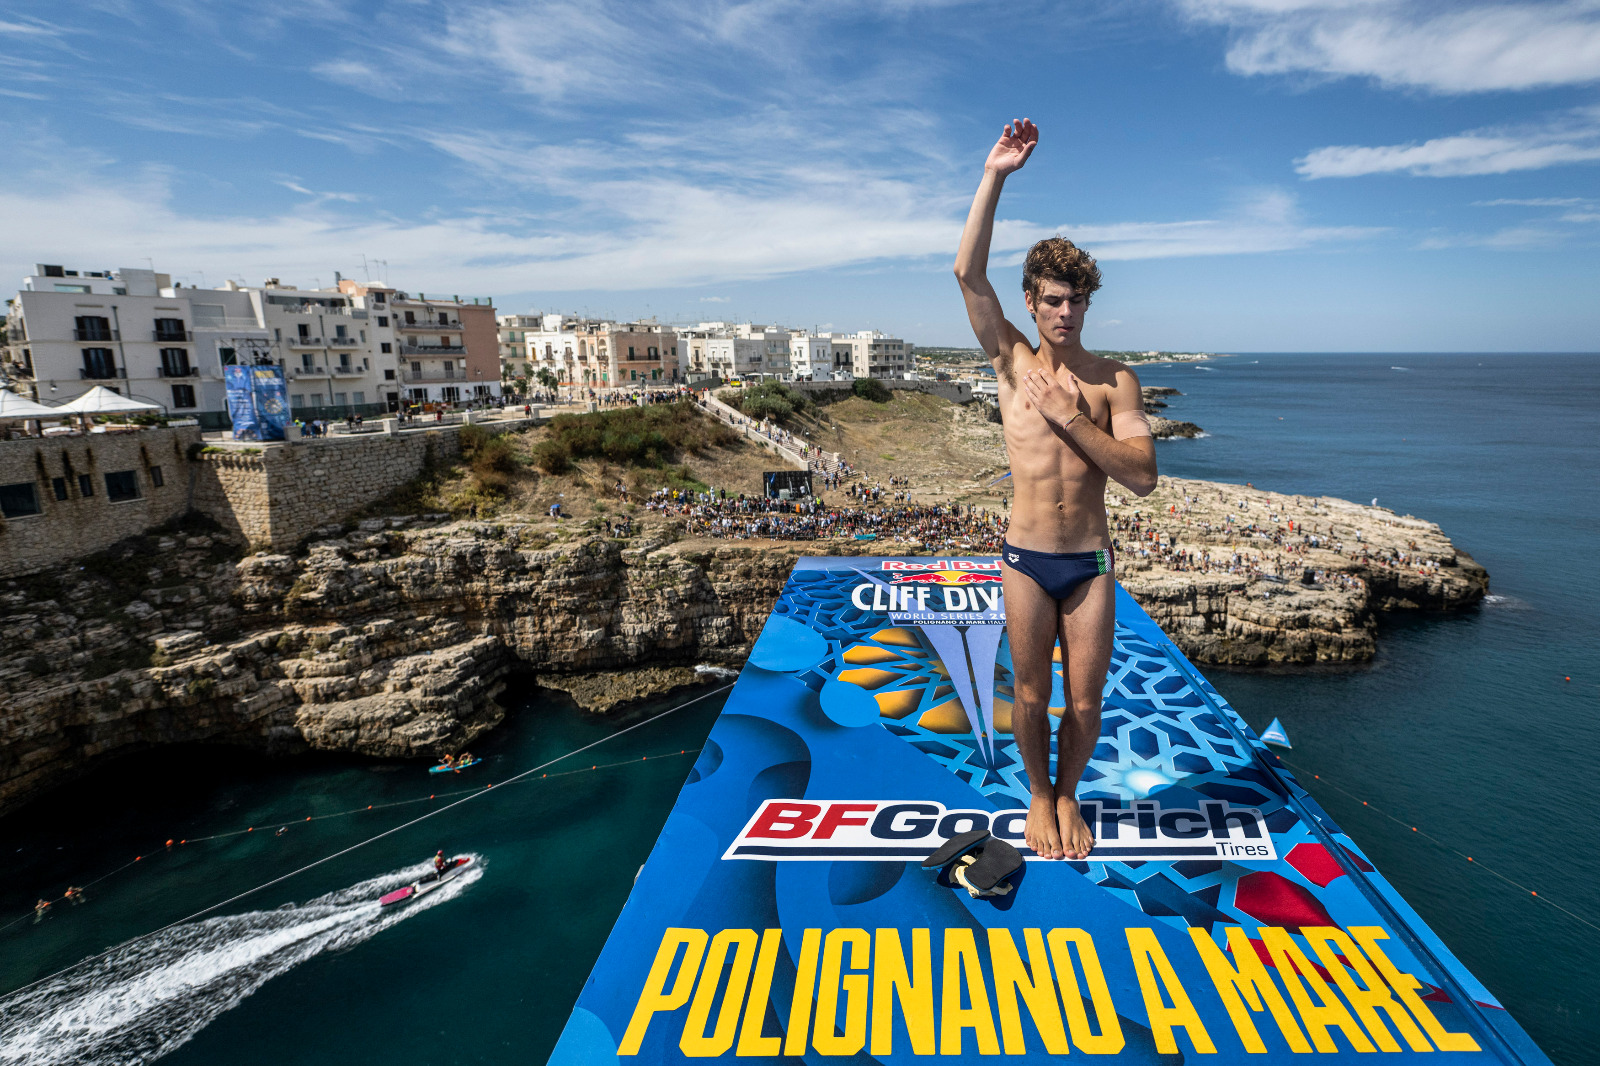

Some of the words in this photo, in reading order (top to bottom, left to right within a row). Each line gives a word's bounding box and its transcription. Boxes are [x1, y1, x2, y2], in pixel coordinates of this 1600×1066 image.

[881, 560, 948, 570] Red
[951, 560, 1003, 570] Bul
[851, 583, 931, 611] CLIFF
[943, 586, 1004, 611] DIV
[891, 612, 935, 620] WORLD
[940, 612, 984, 620] SERIES
[989, 612, 1007, 620] 20
[1216, 841, 1269, 856] Tires
[616, 927, 1126, 1056] POLIGNANO
[1124, 927, 1218, 1055] A
[1188, 926, 1482, 1054] MARE
